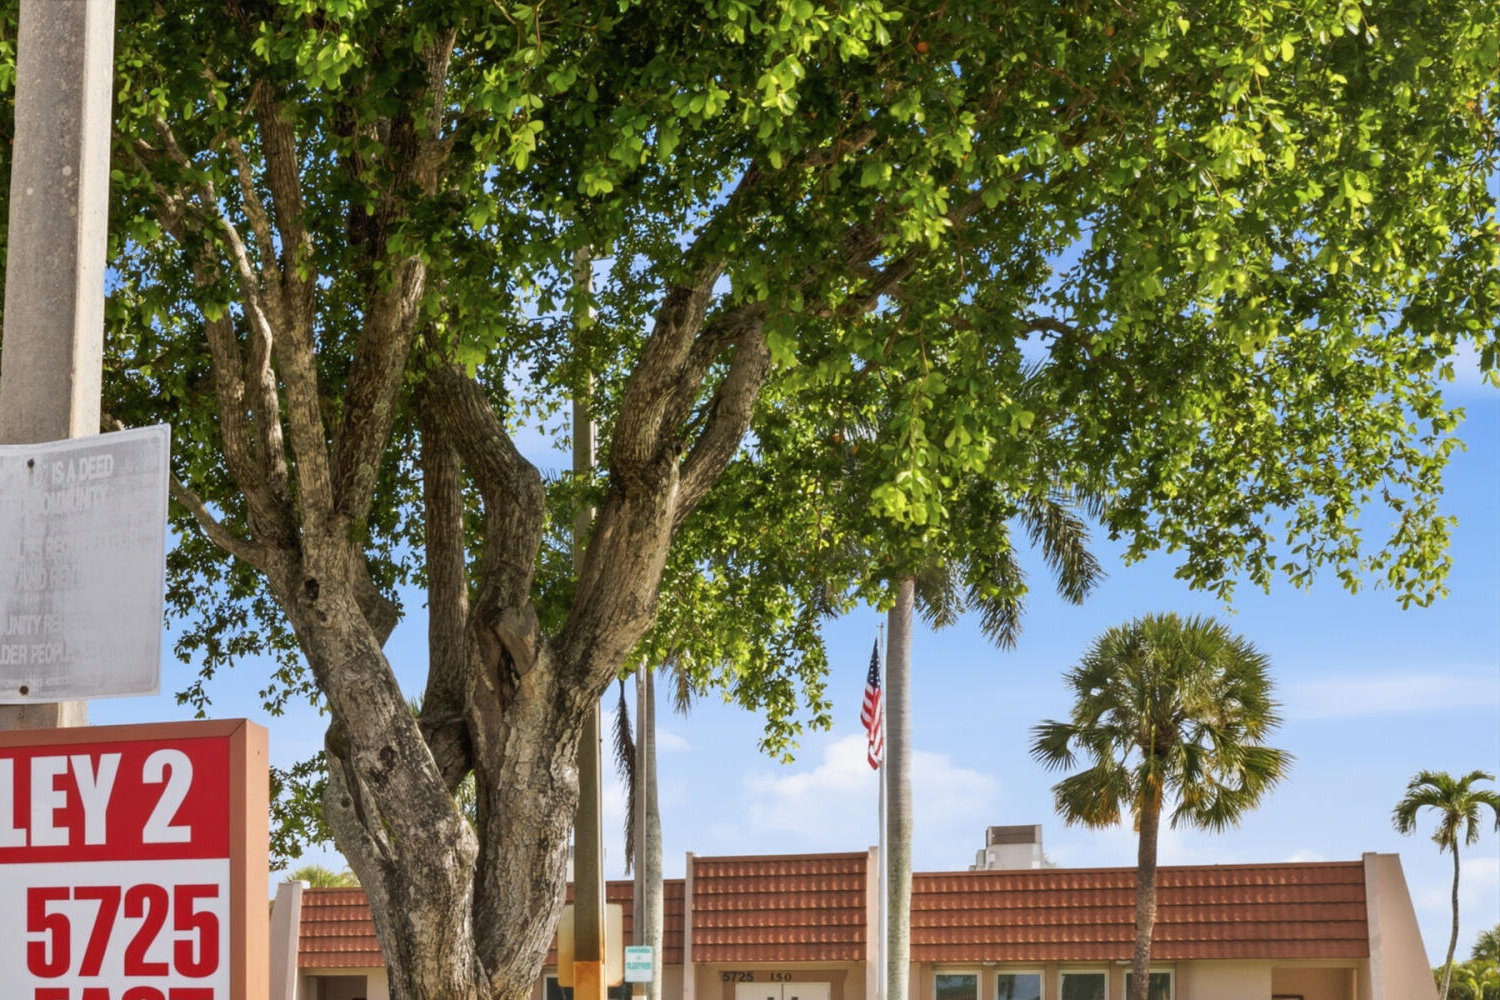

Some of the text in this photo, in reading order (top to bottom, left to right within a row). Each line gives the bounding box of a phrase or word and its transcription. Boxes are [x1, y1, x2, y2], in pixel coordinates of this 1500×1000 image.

[79, 454, 114, 481] DEED
[142, 748, 194, 844] 2
[26, 883, 220, 979] 5725
